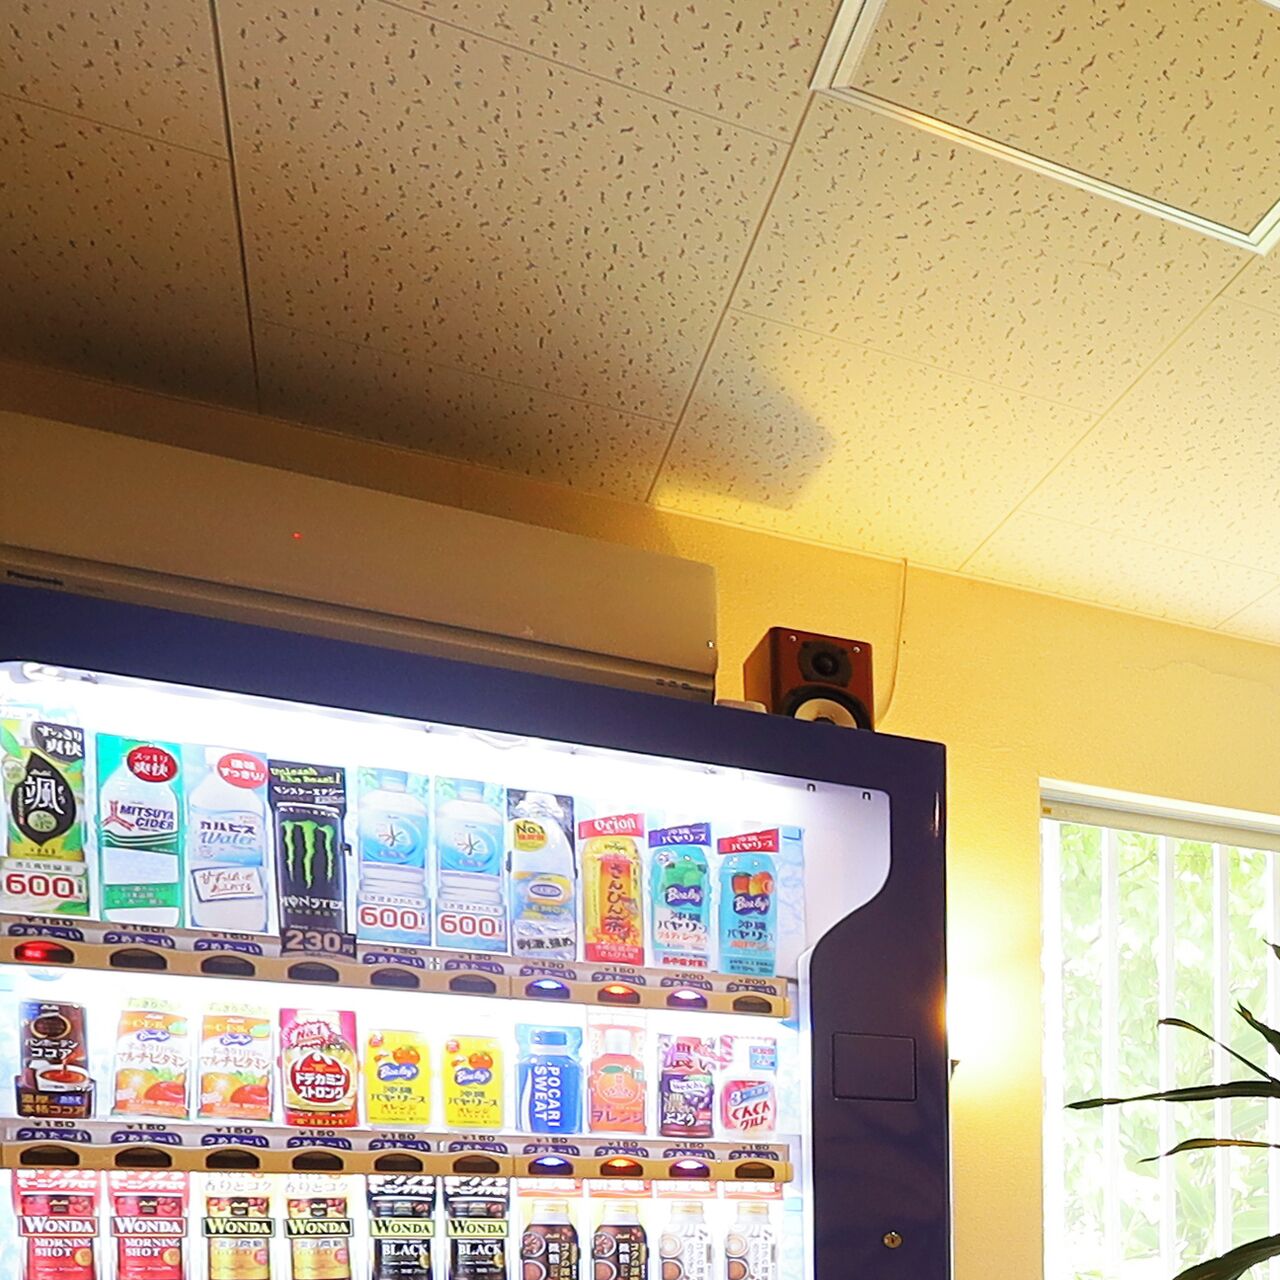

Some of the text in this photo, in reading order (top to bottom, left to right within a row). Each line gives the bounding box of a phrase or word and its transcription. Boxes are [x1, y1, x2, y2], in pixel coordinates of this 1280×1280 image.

[31, 1048, 73, 1058] ココア
[534, 1066, 548, 1121] SWEAT
[547, 1065, 561, 1126] POCARI
[23, 1216, 94, 1233] WONDA
[115, 1217, 181, 1233] WONDA
[206, 1218, 271, 1234] WONDA
[287, 1219, 349, 1234] WONDA
[375, 1220, 431, 1234] WONDA
[450, 1220, 505, 1234] WONDA
[34, 1247, 72, 1257] SHOT
[125, 1248, 161, 1257] SHOT
[384, 1243, 428, 1256] BLACK
[459, 1243, 502, 1255] BLACK
